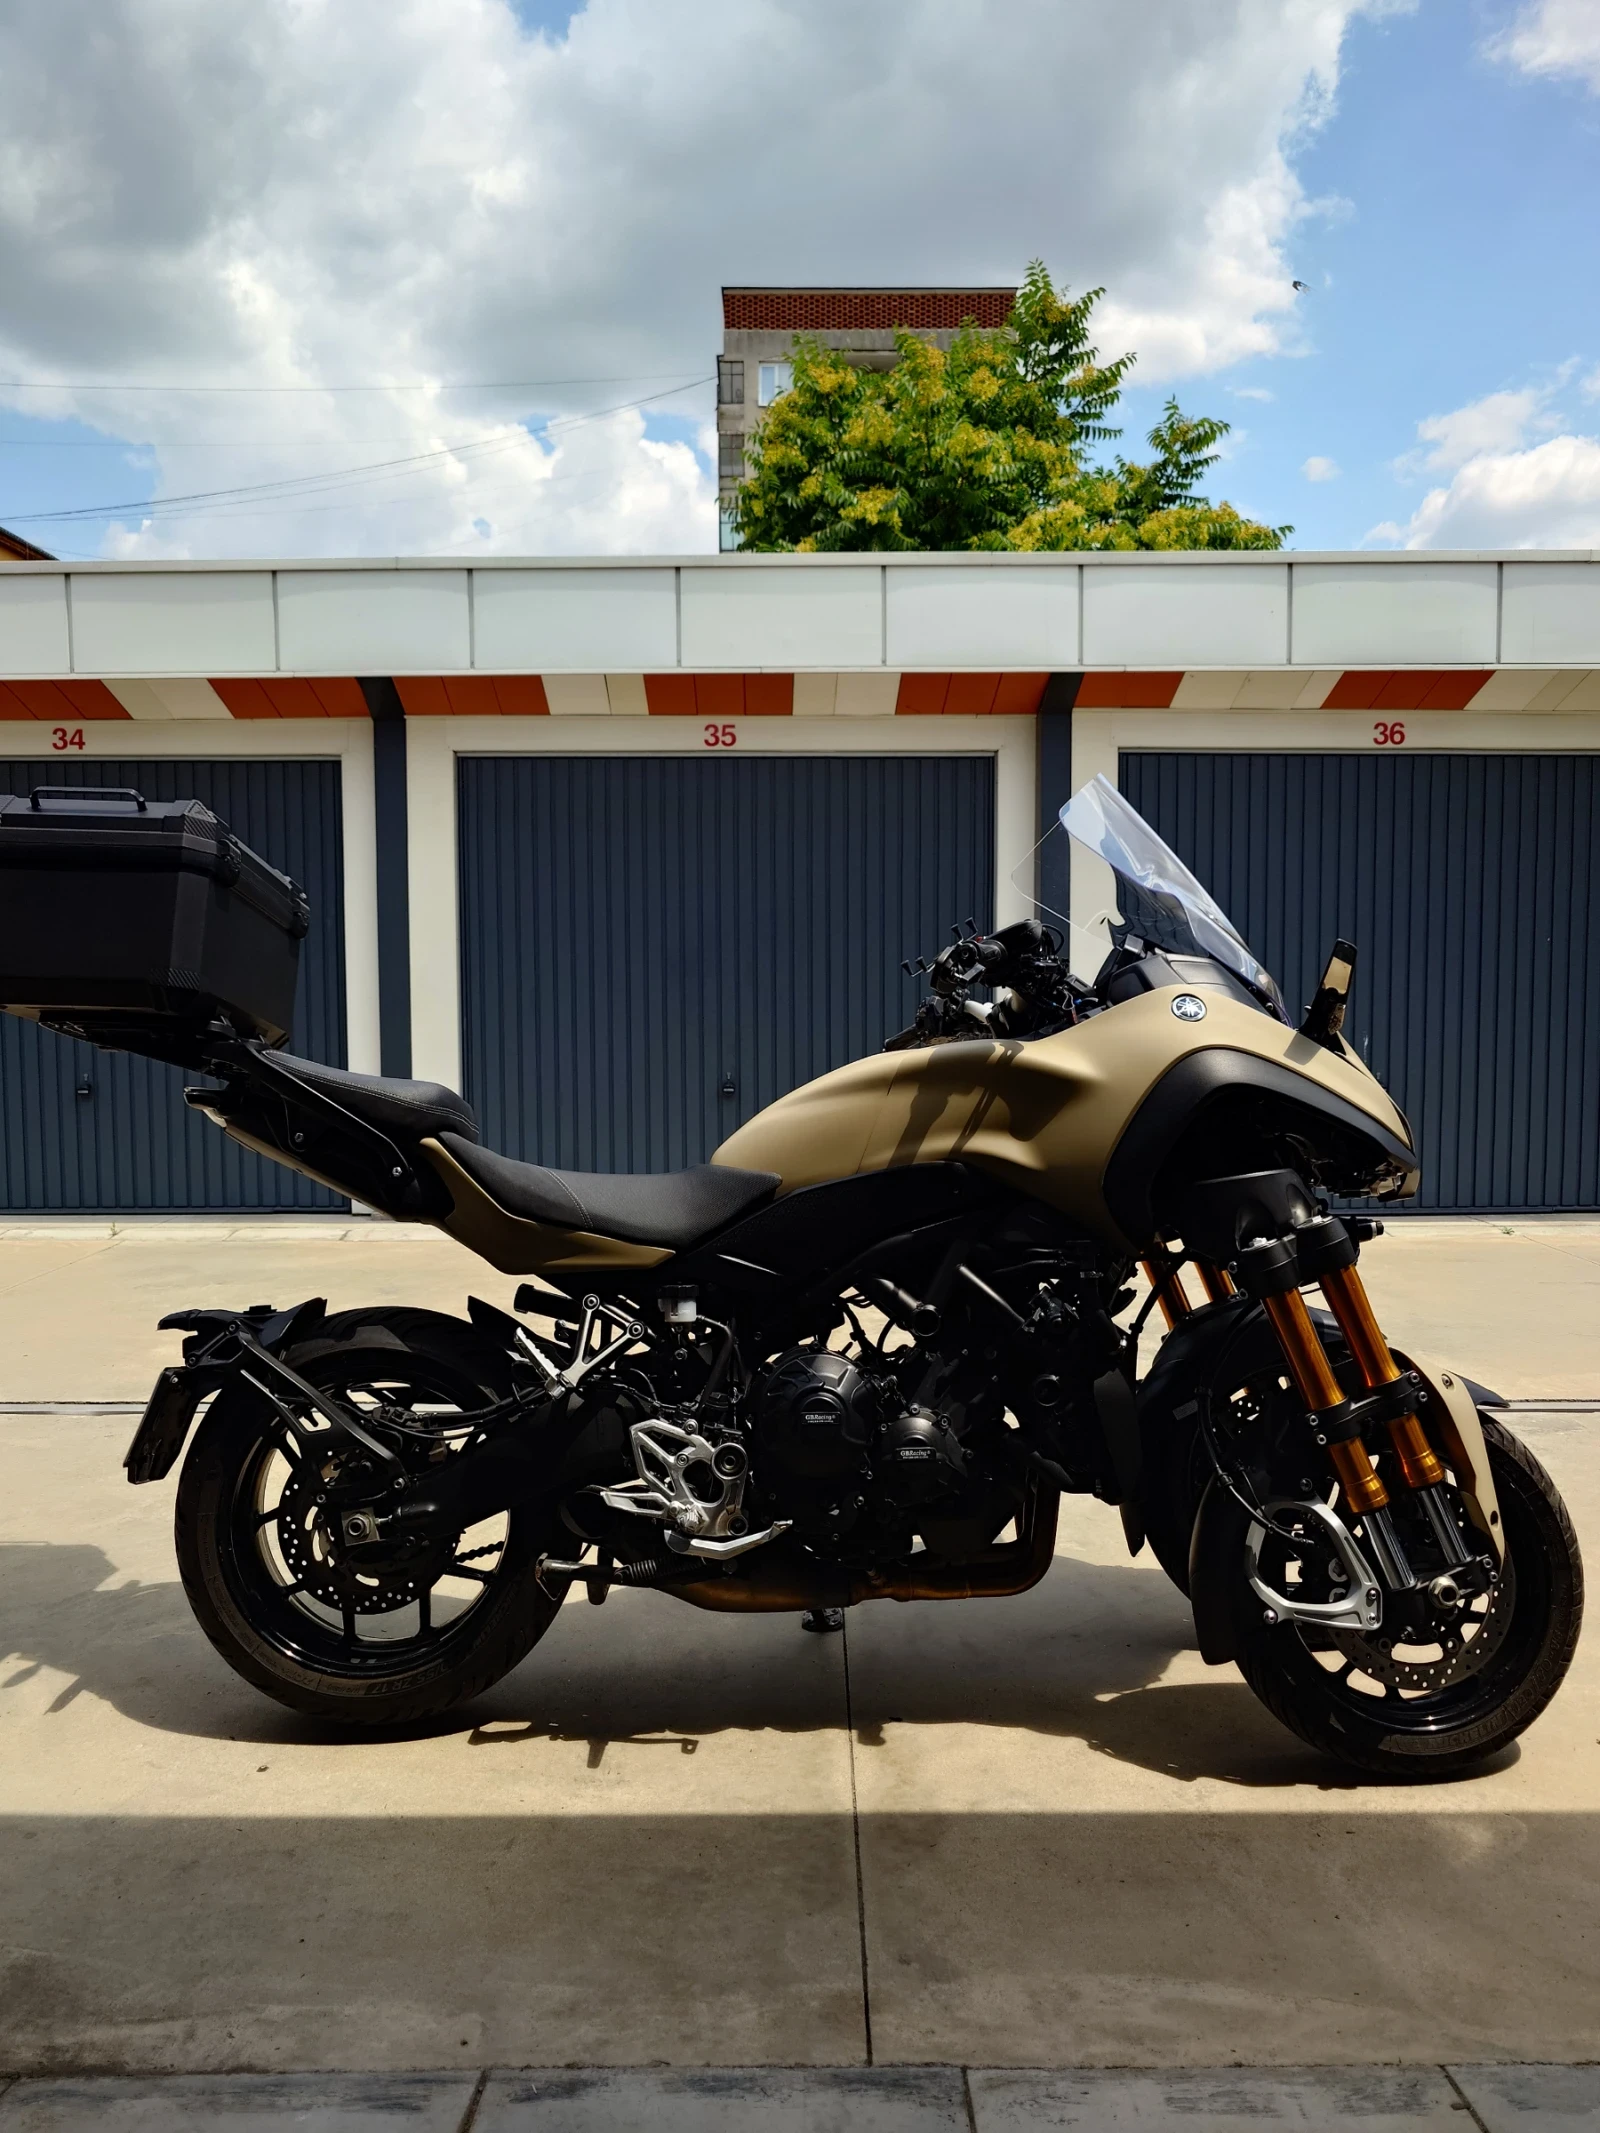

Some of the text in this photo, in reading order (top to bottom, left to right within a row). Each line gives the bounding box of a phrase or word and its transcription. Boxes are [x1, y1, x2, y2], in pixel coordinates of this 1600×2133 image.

[52, 727, 86, 750] 34
[704, 723, 737, 747] 35
[1373, 721, 1405, 745] 36
